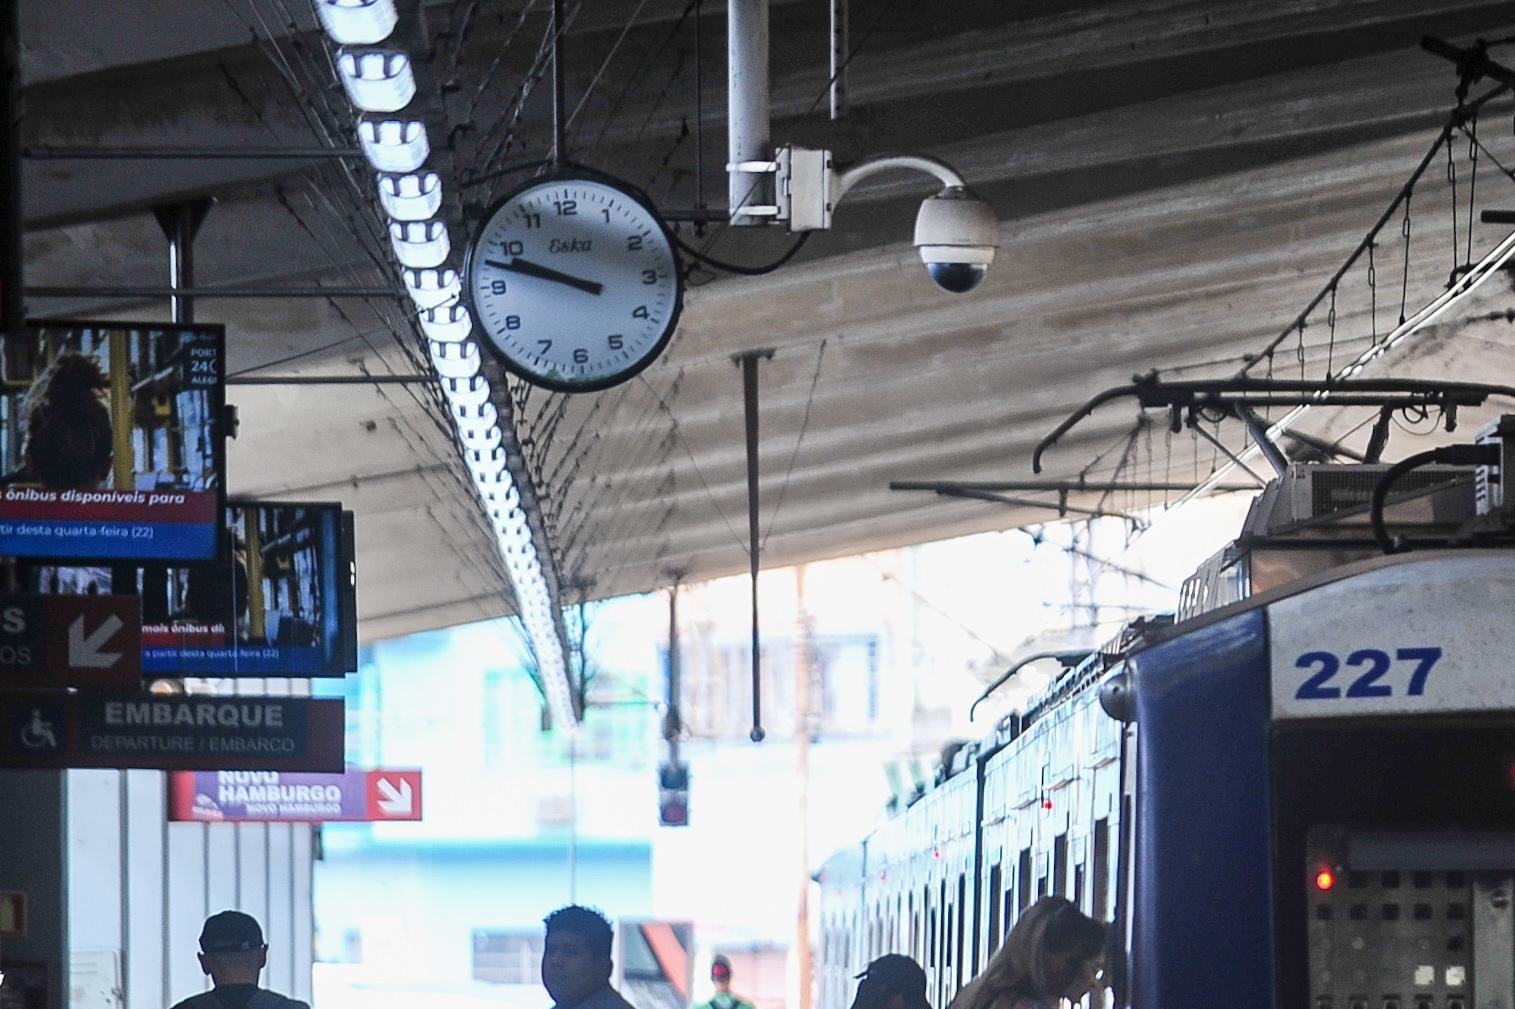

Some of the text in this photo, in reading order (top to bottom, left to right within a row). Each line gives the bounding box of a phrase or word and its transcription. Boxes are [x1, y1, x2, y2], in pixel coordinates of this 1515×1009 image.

[554, 200, 577, 216] 12
[602, 208, 611, 223] 1
[524, 214, 541, 229] 11
[499, 240, 524, 257] 10
[627, 235, 643, 251] 2
[641, 270, 658, 285] 3
[491, 280, 507, 295] 9
[632, 305, 650, 320] 4
[505, 315, 521, 330] 8
[537, 339, 553, 355] 7
[608, 334, 624, 350] 5
[573, 348, 589, 364] 6
[6, 488, 185, 506] ônibus disponíveis para
[17, 525, 54, 535] desta
[55, 526, 129, 537] quarta-feira
[131, 527, 154, 539] (22)
[1294, 646, 1443, 700] 227
[104, 702, 284, 728] EMBARQUE
[91, 735, 195, 752] DEPARTURE
[209, 736, 295, 753] EMBARCO
[218, 770, 280, 785] NOVO
[218, 785, 343, 803] HAMBURGO
